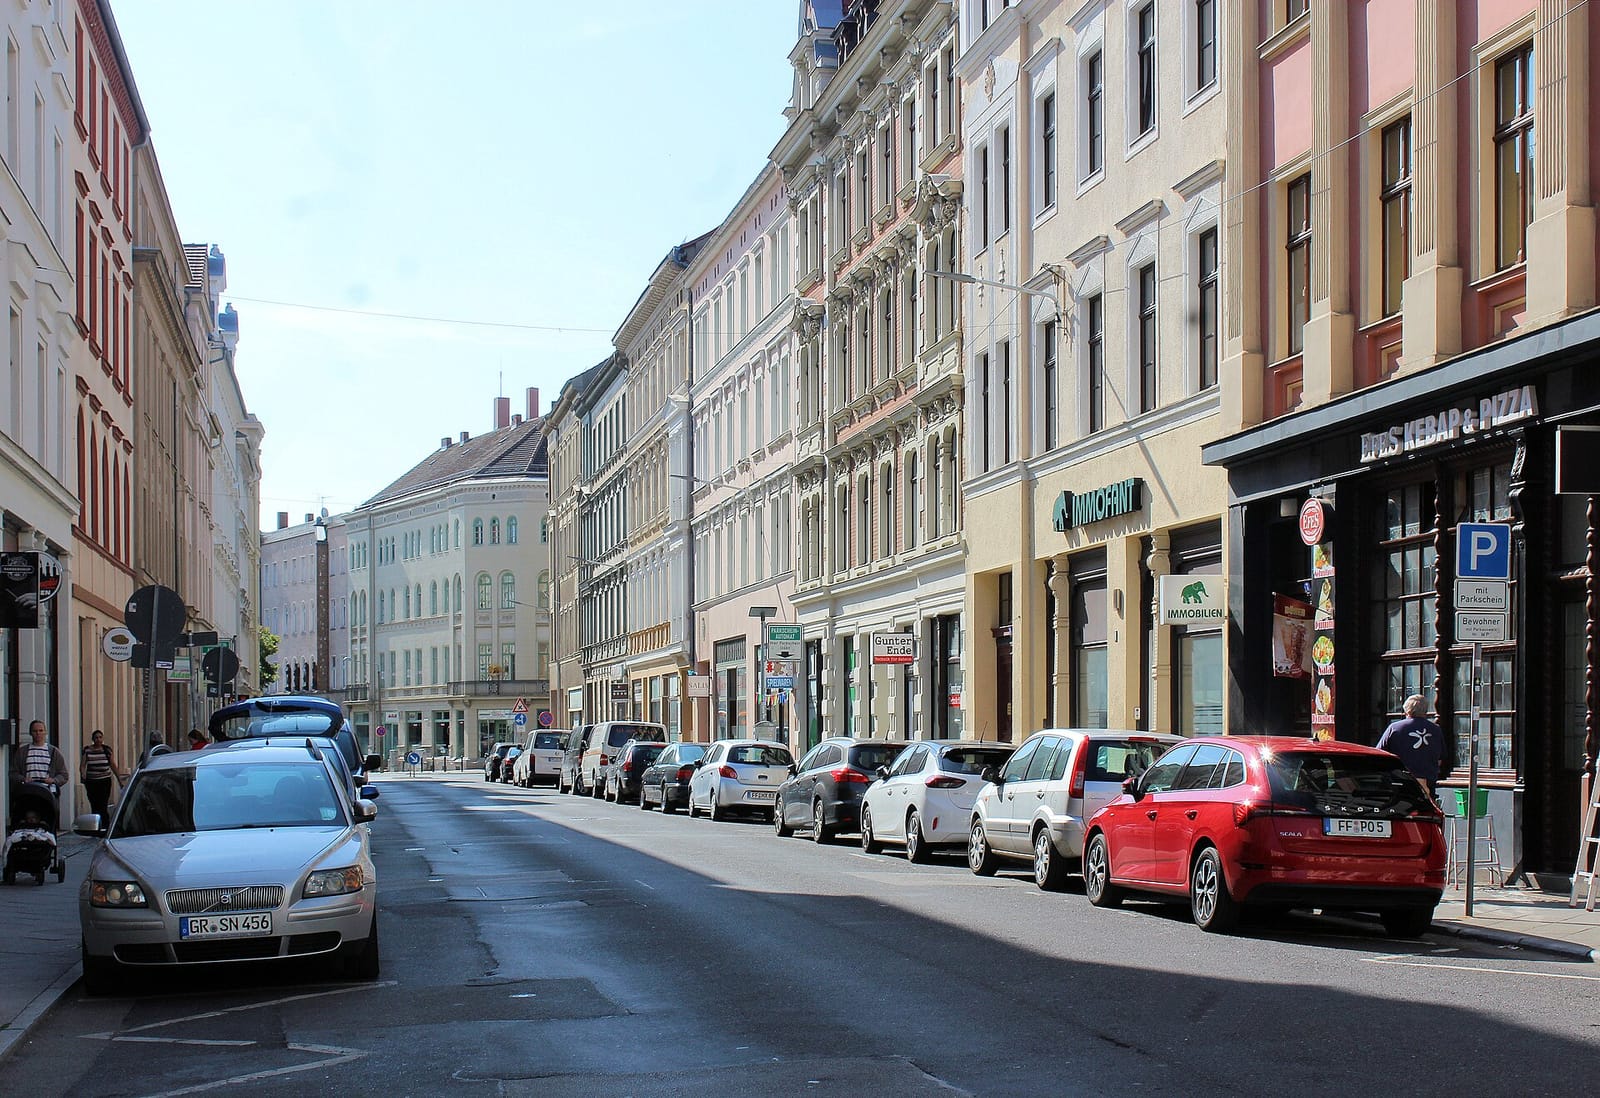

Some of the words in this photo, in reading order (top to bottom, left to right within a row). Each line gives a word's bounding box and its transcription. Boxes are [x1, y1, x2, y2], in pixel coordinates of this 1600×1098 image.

[1404, 408, 1460, 450] KEBAP
[1463, 408, 1478, 434] &
[1480, 385, 1539, 430] PIZZA
[1072, 479, 1135, 527] IMMOFANT
[1470, 530, 1497, 570] P
[1460, 595, 1503, 603] Parkschein
[1167, 608, 1223, 619] IMMOBILIEN
[1462, 617, 1501, 626] Bewohner
[874, 636, 912, 645] Gunter
[887, 646, 912, 655] Ende
[1338, 820, 1353, 831] FF
[190, 919, 209, 933] GR
[220, 917, 239, 932] SN
[242, 915, 269, 930] 456
